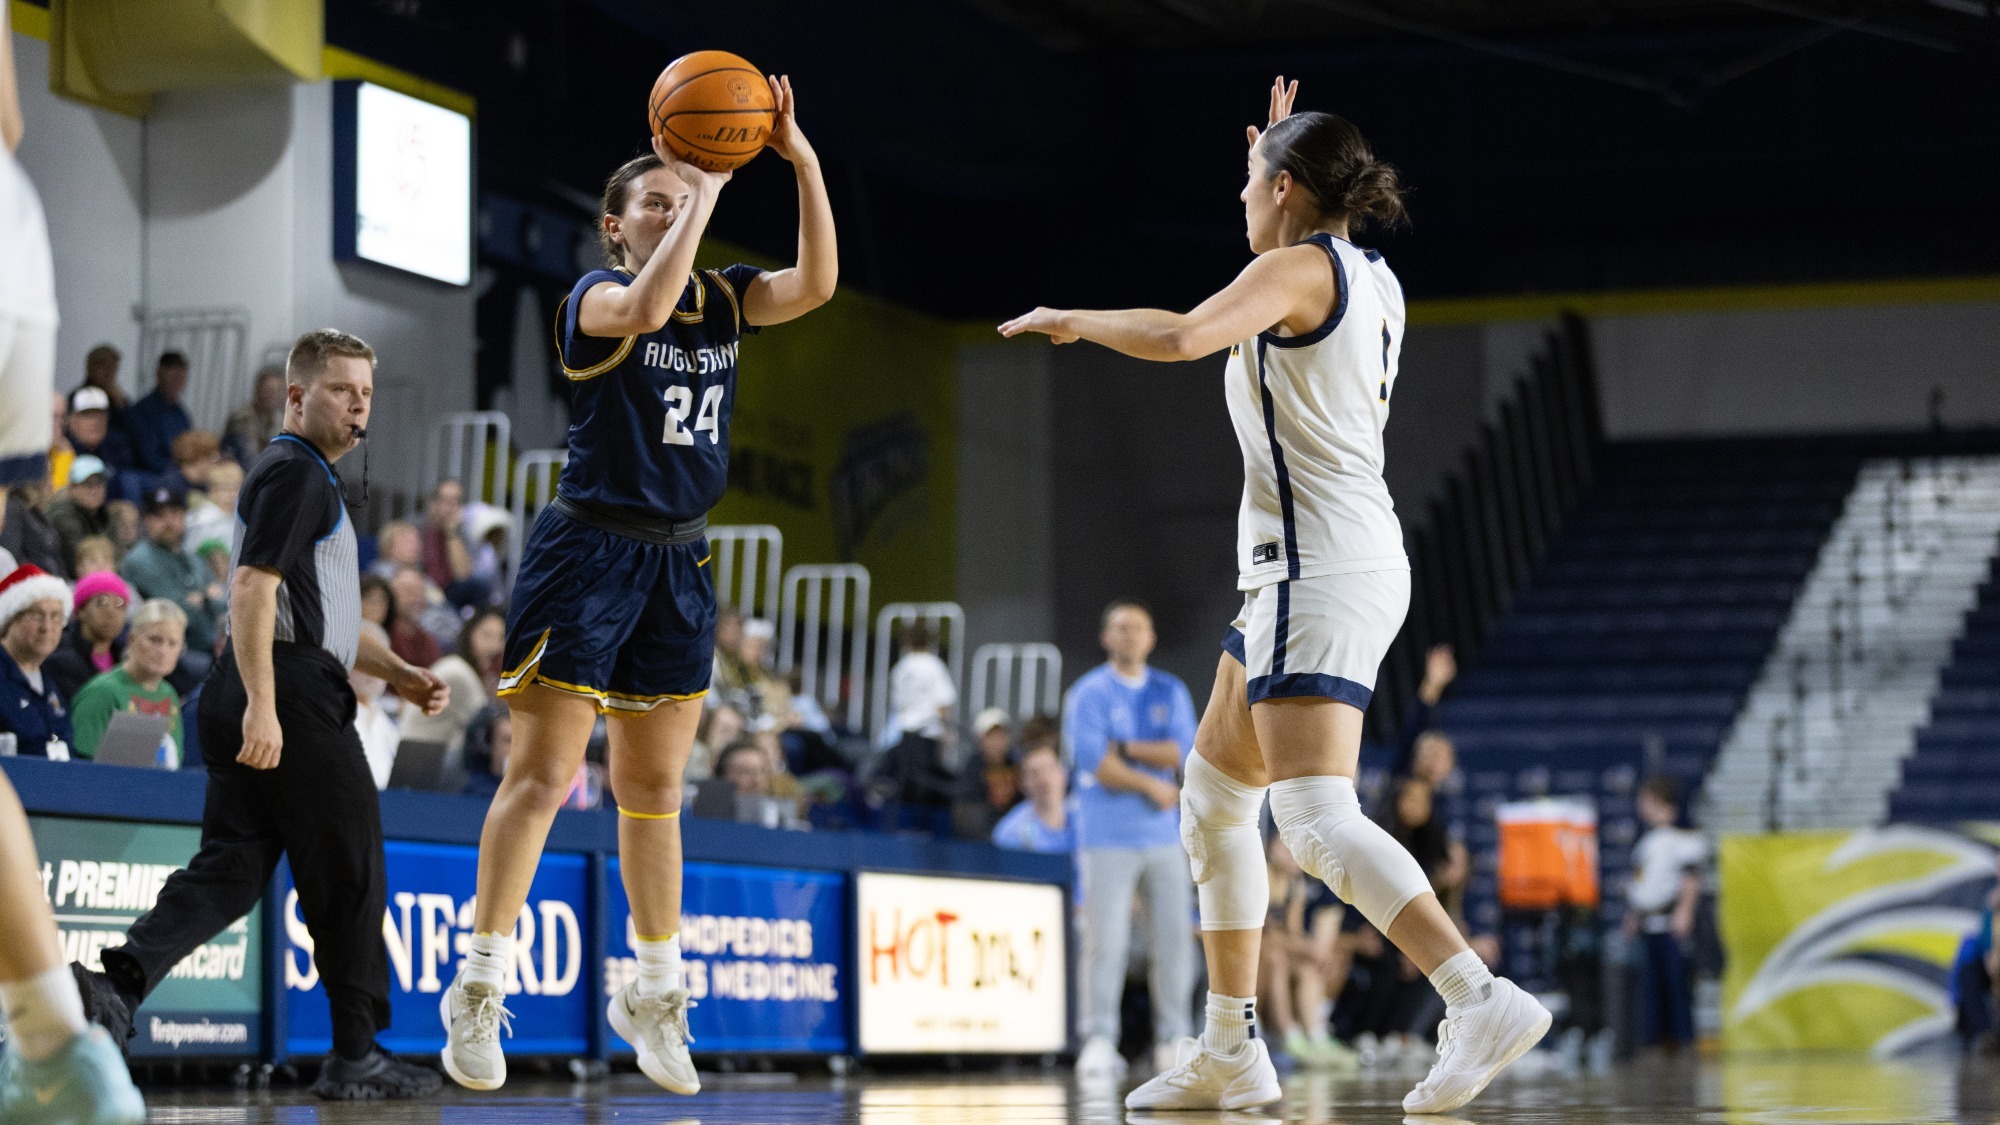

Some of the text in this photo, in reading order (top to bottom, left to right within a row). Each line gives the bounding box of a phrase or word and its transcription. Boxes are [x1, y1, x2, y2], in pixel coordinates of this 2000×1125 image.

[662, 384, 725, 446] 24
[55, 859, 185, 911] PREMIE
[285, 887, 582, 997] SNFRD
[626, 914, 813, 959] HOPEDICS
[870, 908, 960, 987] HOT
[712, 962, 839, 1002] MEDICINE
